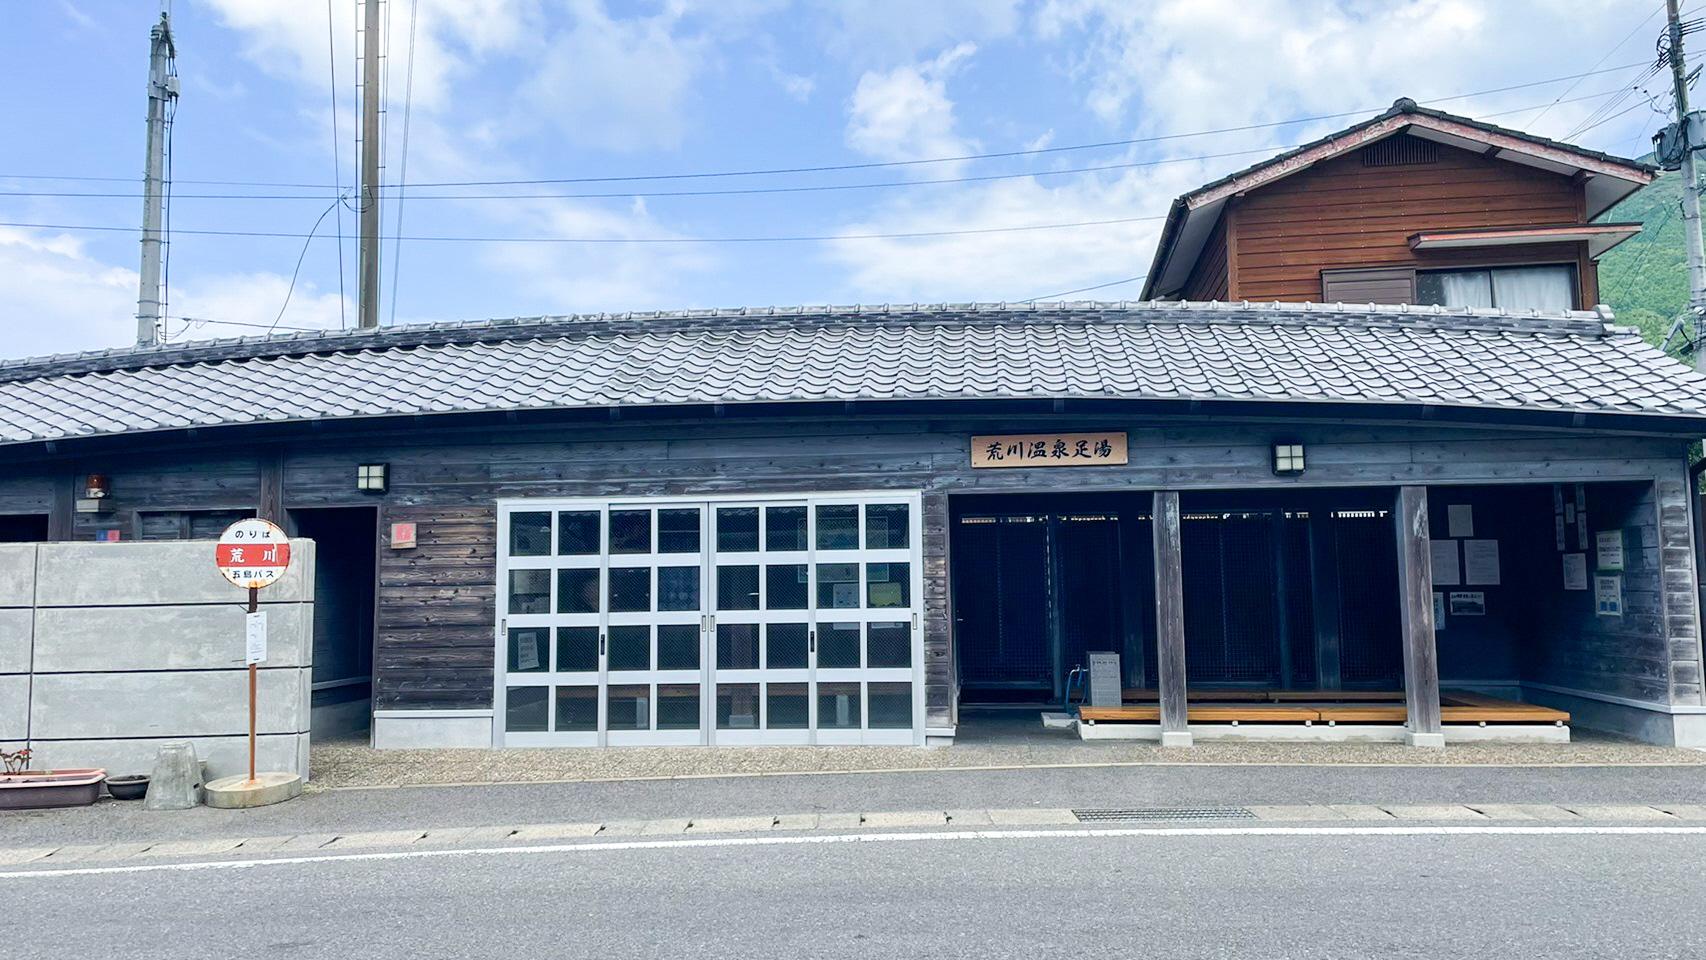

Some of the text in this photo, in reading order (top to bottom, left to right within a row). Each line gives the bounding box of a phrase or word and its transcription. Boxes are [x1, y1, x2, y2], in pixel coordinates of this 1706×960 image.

[986, 439, 1112, 461] 荒川温泉足湯
[230, 548, 276, 562] 荒川
[232, 570, 274, 579] 五島バス
